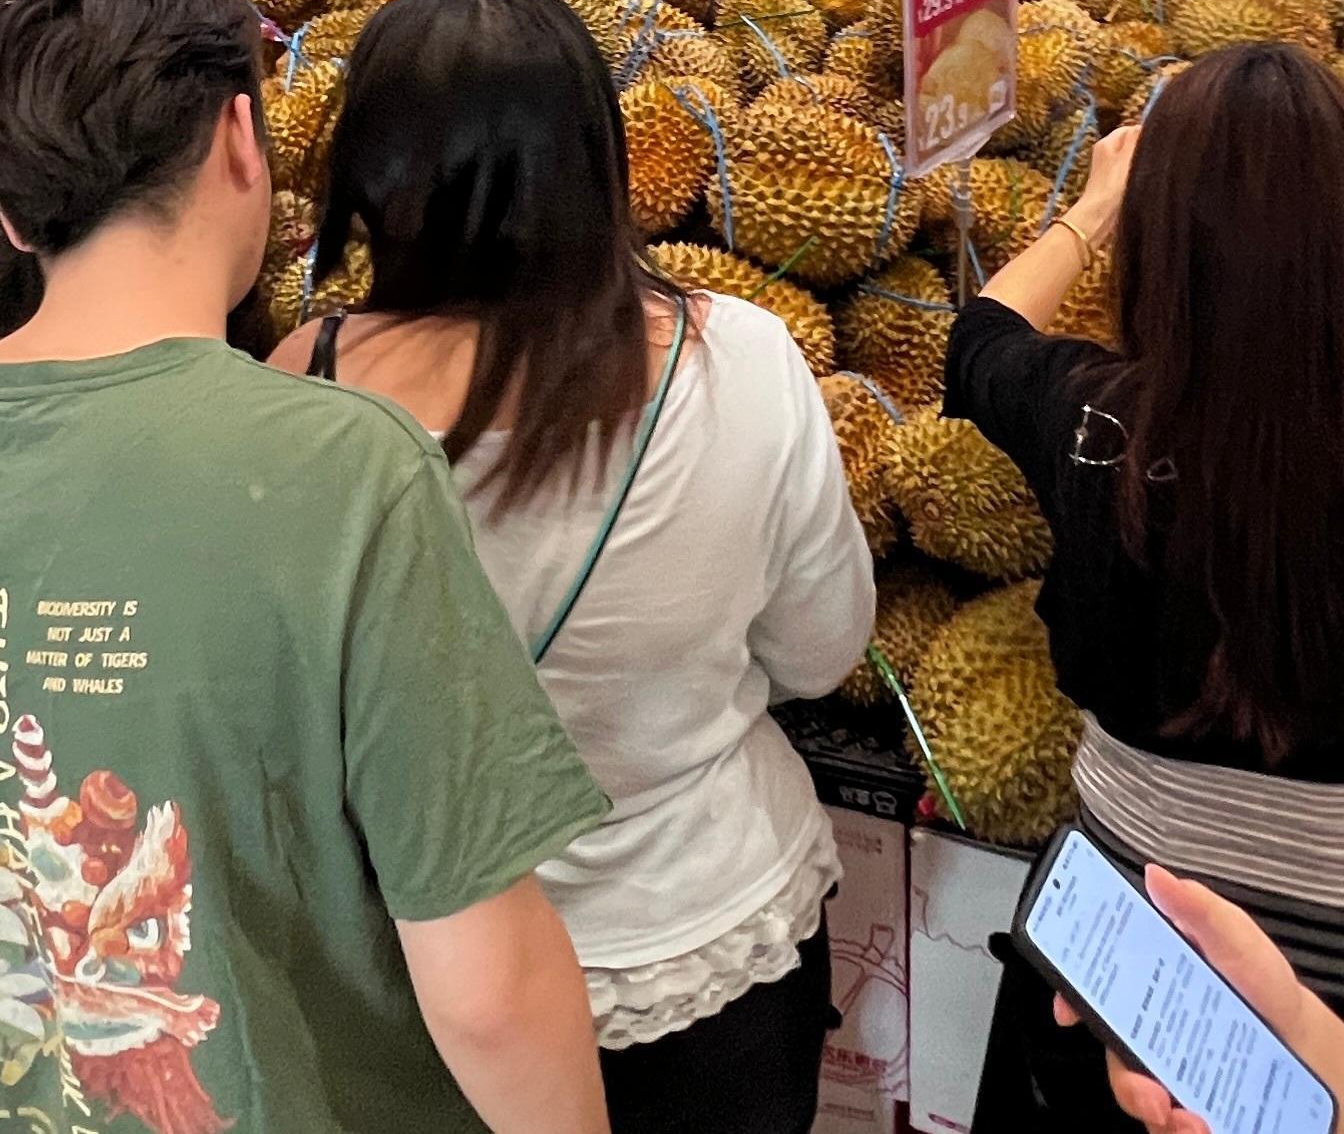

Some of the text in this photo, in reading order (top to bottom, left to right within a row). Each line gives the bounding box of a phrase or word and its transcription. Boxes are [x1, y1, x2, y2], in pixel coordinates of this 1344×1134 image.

[37, 600, 139, 617] BIODIVERSITY IS
[47, 625, 131, 643] NOT JUST A
[26, 650, 148, 669] MATTER OF TIGERS
[42, 676, 124, 694] AND WHALES
